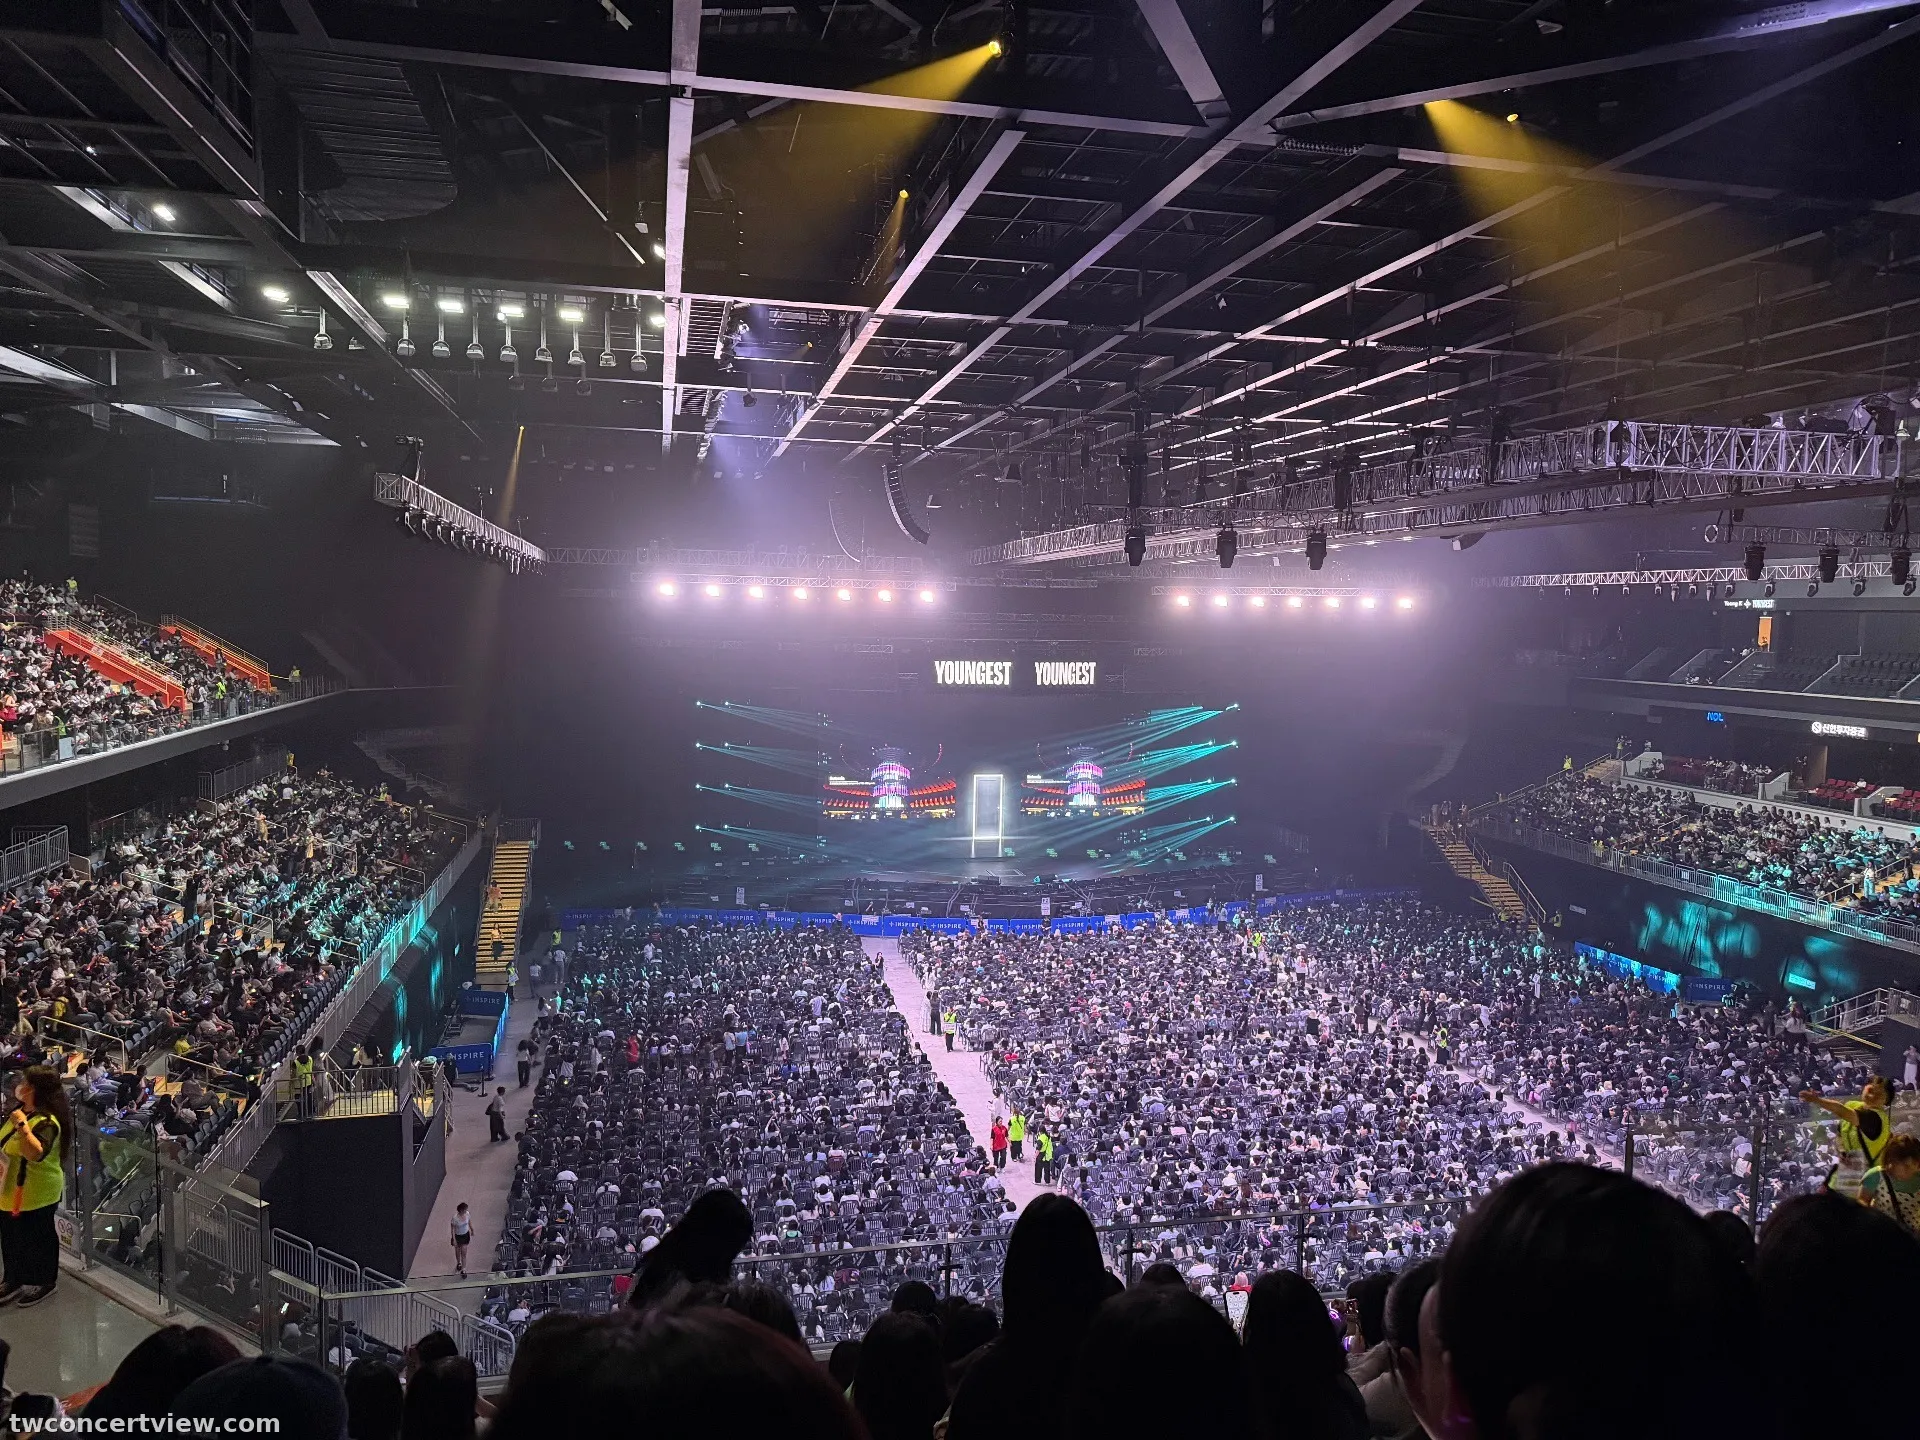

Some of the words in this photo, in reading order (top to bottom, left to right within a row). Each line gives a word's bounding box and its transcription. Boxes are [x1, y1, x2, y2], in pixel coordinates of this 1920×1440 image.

[934, 660, 1012, 685] YOUNGEST
[1034, 661, 1096, 685] YOUNGEST
[1707, 711, 1723, 721] NOL
[472, 996, 500, 1005] INSPIRE
[450, 1052, 484, 1060] NSPIRE
